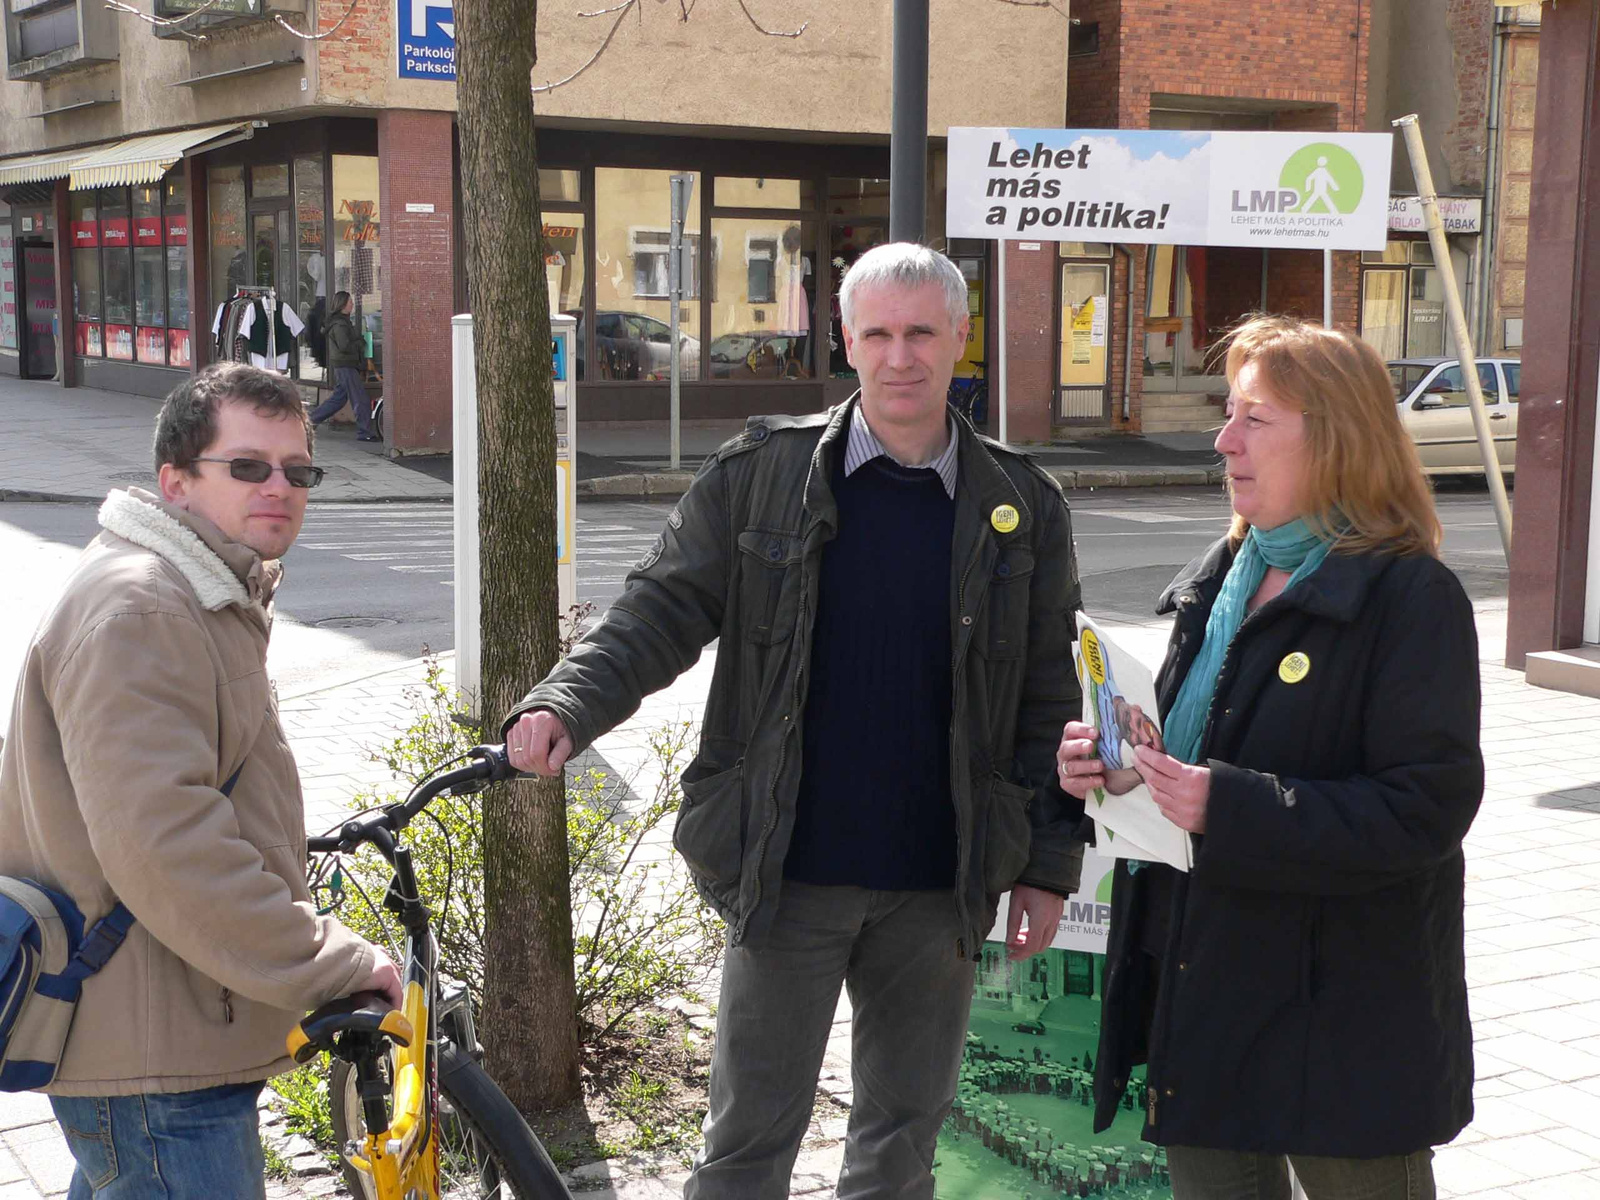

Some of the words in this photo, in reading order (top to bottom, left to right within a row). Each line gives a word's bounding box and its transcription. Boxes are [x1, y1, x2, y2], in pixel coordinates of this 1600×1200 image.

[406, 59, 457, 74] Parksch
[987, 141, 1092, 169] Lehet
[985, 172, 1062, 199] más
[1231, 189, 1298, 213] LMP
[985, 205, 1008, 225] a
[1016, 201, 1170, 231] politika!
[1231, 215, 1262, 225] LEHET
[1264, 216, 1286, 226] MÁS
[1288, 217, 1296, 226] A
[1298, 217, 1344, 227] POLITIKA
[1442, 218, 1476, 230] TABAK
[1249, 228, 1330, 238] www.lehetmas.hu
[1058, 924, 1081, 934] EHET
[1083, 925, 1103, 936] MÁS
